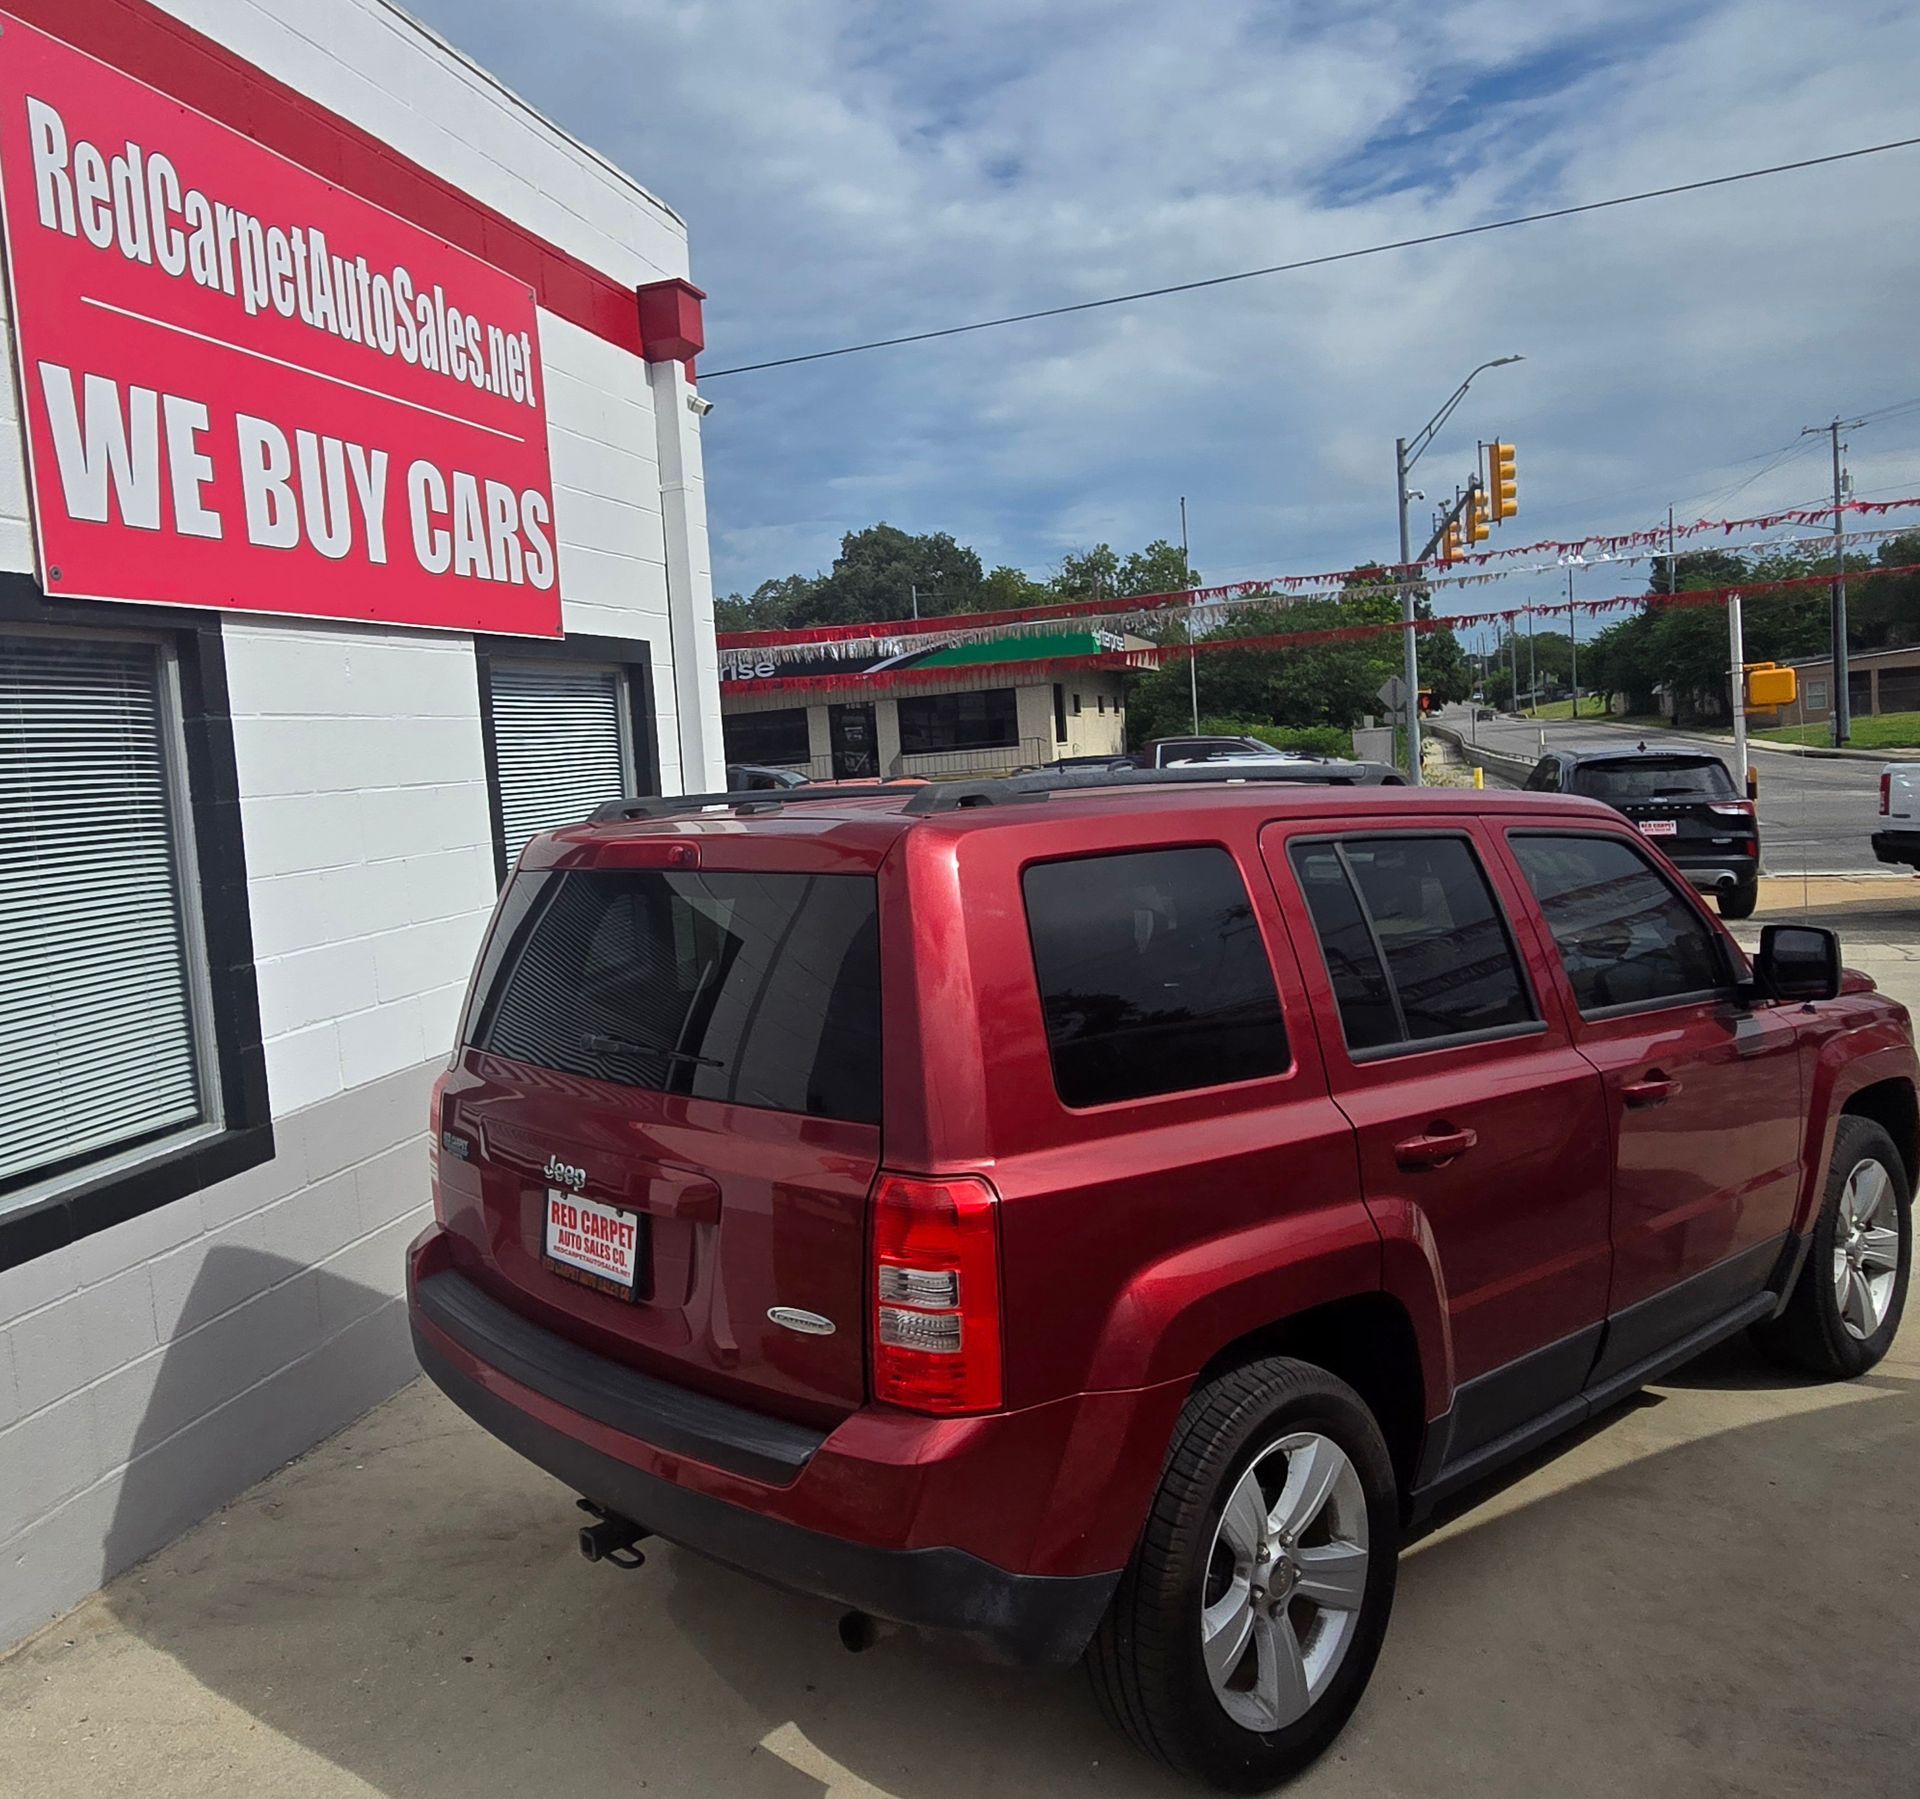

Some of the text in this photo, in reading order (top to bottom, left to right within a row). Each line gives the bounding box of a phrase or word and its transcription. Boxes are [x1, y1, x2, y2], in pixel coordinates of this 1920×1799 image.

[25, 95, 536, 407] RedCarpetAutoSales.net
[38, 360, 555, 590] WE BUY CARS
[544, 1155, 586, 1192] Jeep
[551, 1200, 634, 1250] RED CARPET
[558, 1229, 628, 1268] AUTO SALES CO.
